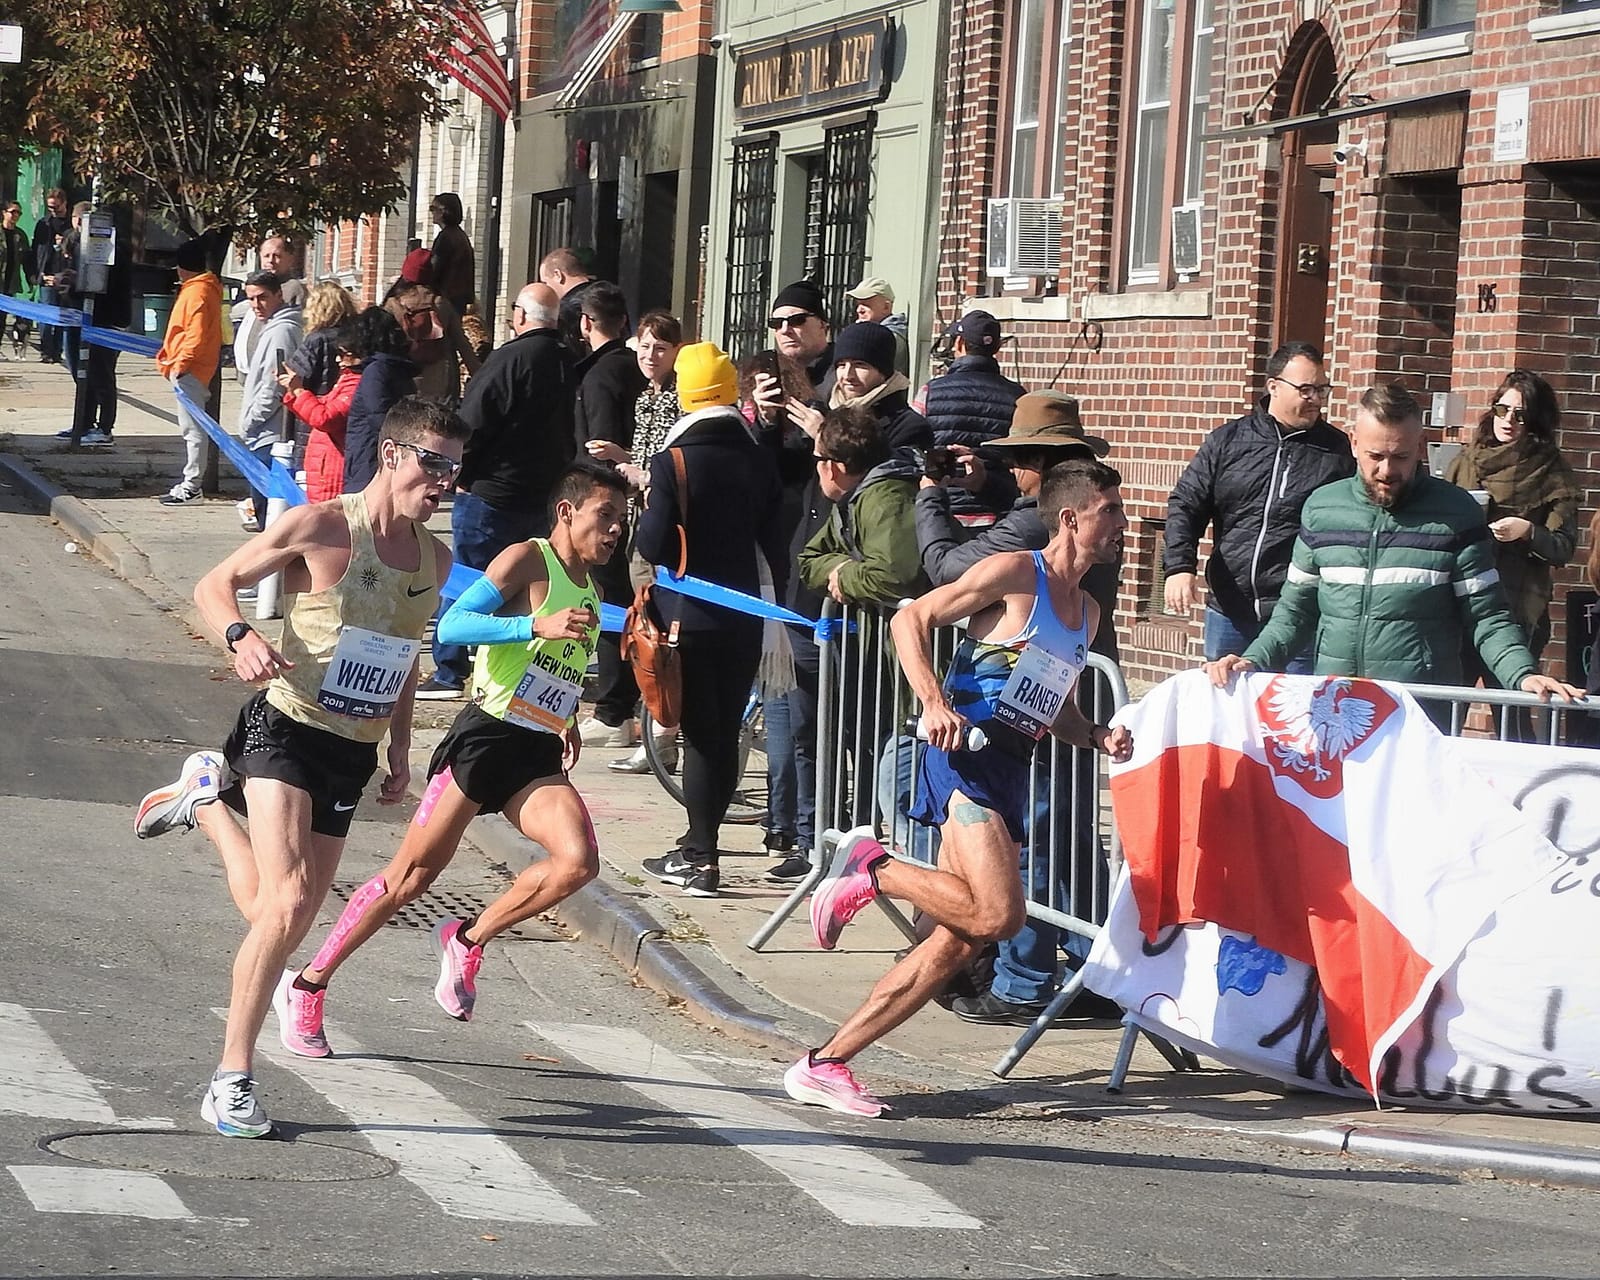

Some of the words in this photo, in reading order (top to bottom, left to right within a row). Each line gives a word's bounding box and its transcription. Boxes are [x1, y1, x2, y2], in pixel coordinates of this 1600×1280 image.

[808, 34, 874, 94] MAKET
[1477, 283, 1497, 313] 195
[563, 643, 576, 661] OF
[337, 659, 406, 695] WHELAN
[532, 651, 559, 675] NEW
[559, 662, 584, 687] YORK
[516, 675, 533, 697] 2019
[537, 685, 567, 713] 445
[323, 696, 345, 708] 2019
[998, 706, 1017, 720] 2019
